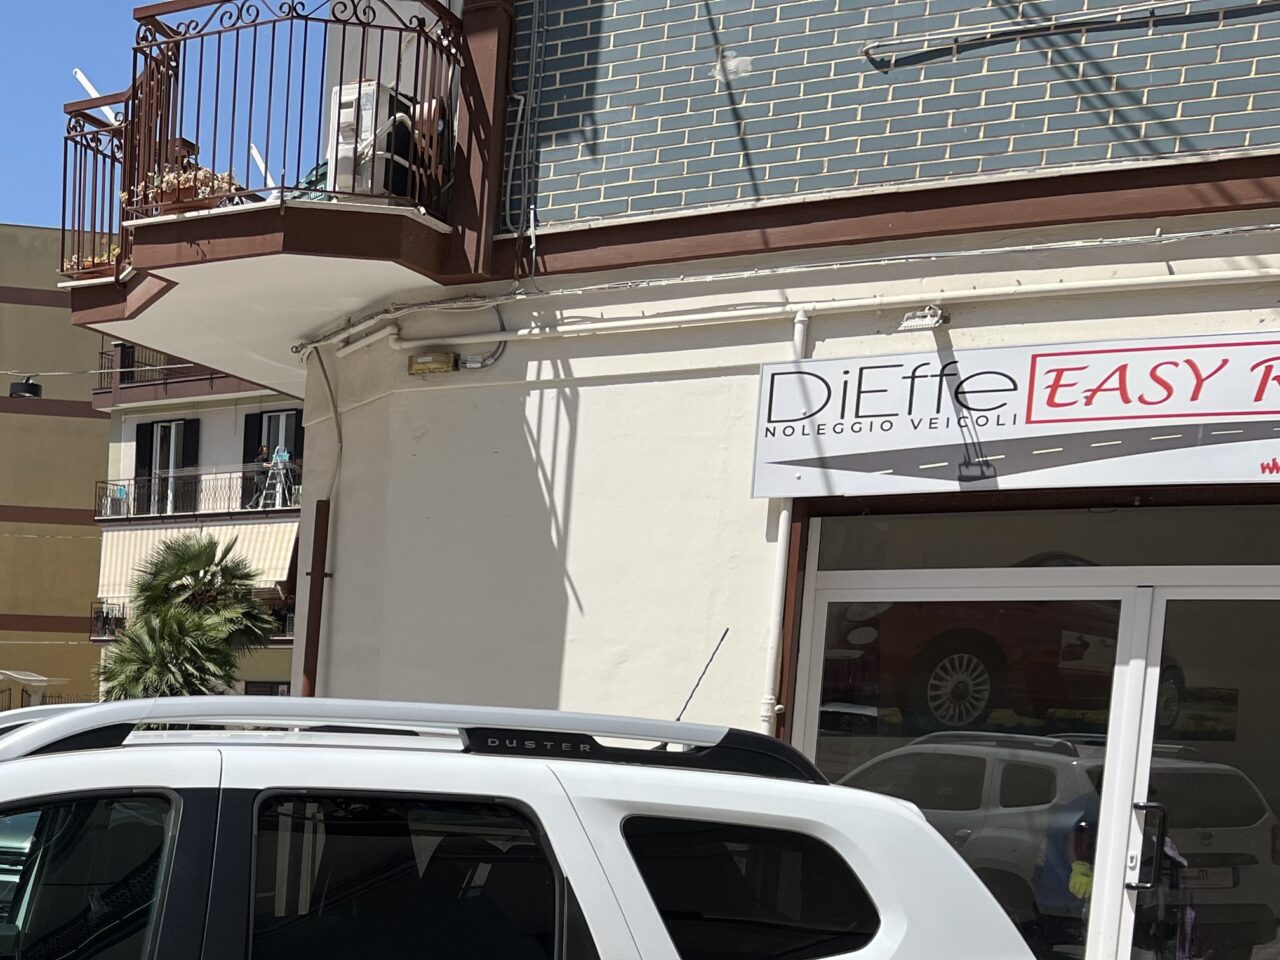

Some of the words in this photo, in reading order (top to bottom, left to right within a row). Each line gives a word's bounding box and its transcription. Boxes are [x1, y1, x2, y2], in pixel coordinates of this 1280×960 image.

[765, 361, 1019, 424] DiEffe
[1043, 358, 1230, 409] EASY
[764, 419, 895, 439] NOLEGGIO
[911, 413, 1019, 431] VEICOLI
[487, 738, 592, 752] DUSTER
